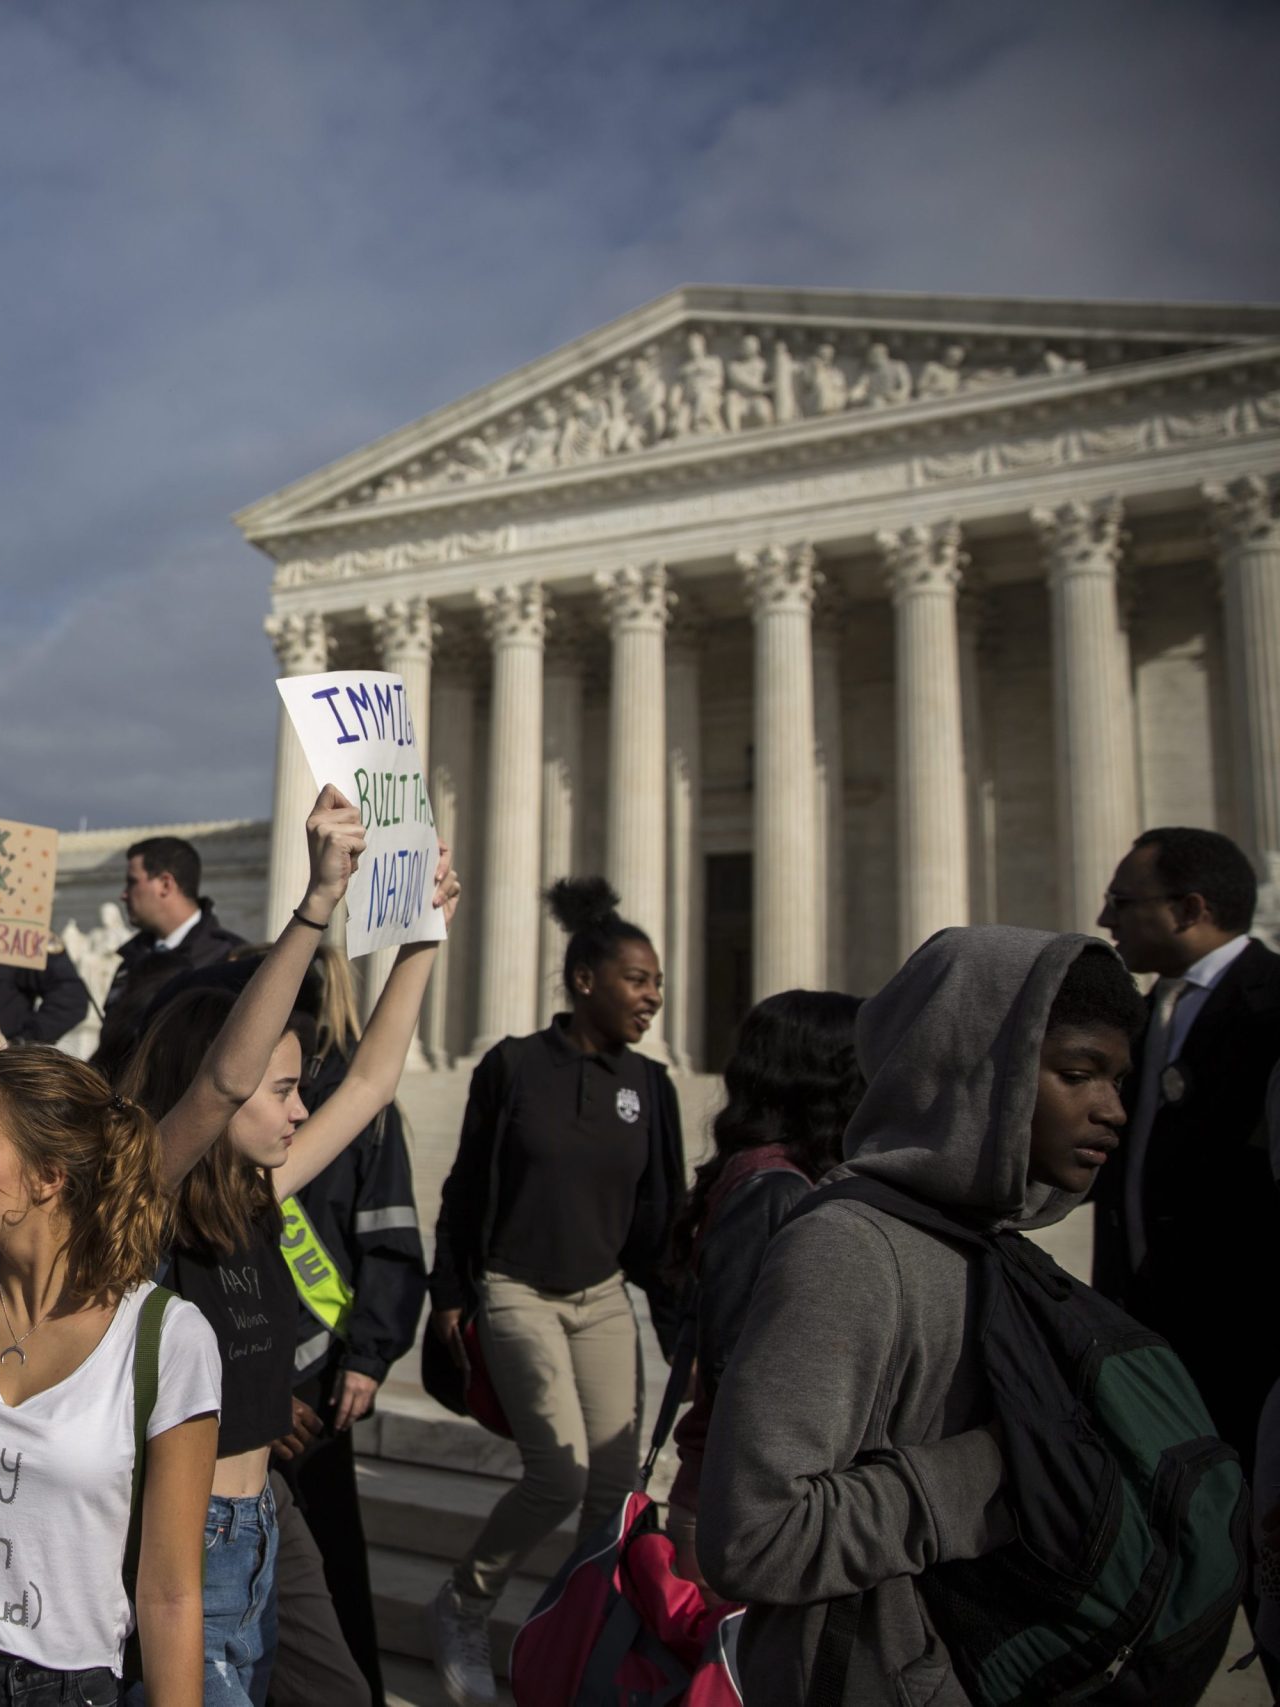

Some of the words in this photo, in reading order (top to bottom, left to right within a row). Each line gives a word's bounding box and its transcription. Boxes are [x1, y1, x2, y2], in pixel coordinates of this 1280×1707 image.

[312, 683, 416, 747] IMMIG
[354, 768, 408, 830] BUILT
[368, 848, 429, 932] NATION
[280, 1215, 331, 1287] CE
